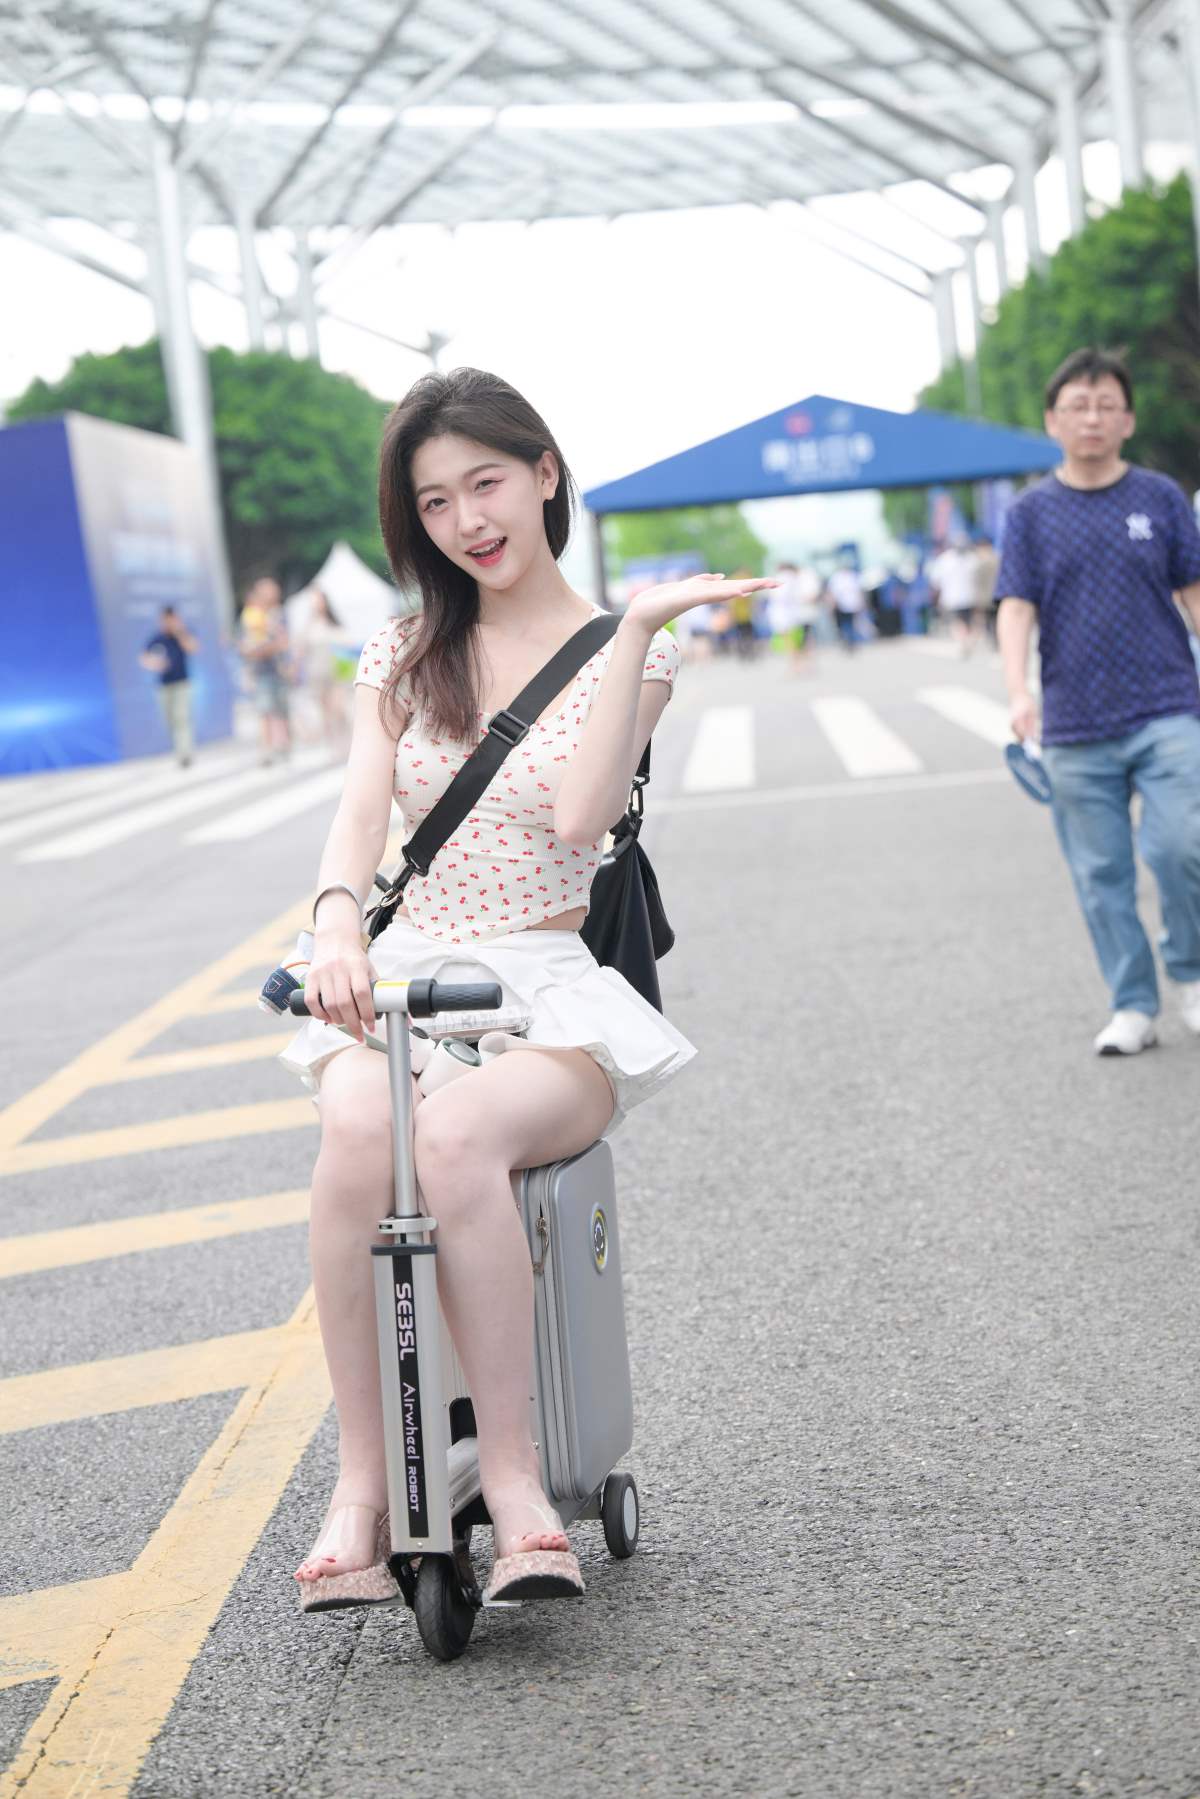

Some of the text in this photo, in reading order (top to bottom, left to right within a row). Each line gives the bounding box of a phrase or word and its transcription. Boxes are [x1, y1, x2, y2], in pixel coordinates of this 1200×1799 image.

[395, 1282, 420, 1512] SE3SL Airwheel ROBOT
